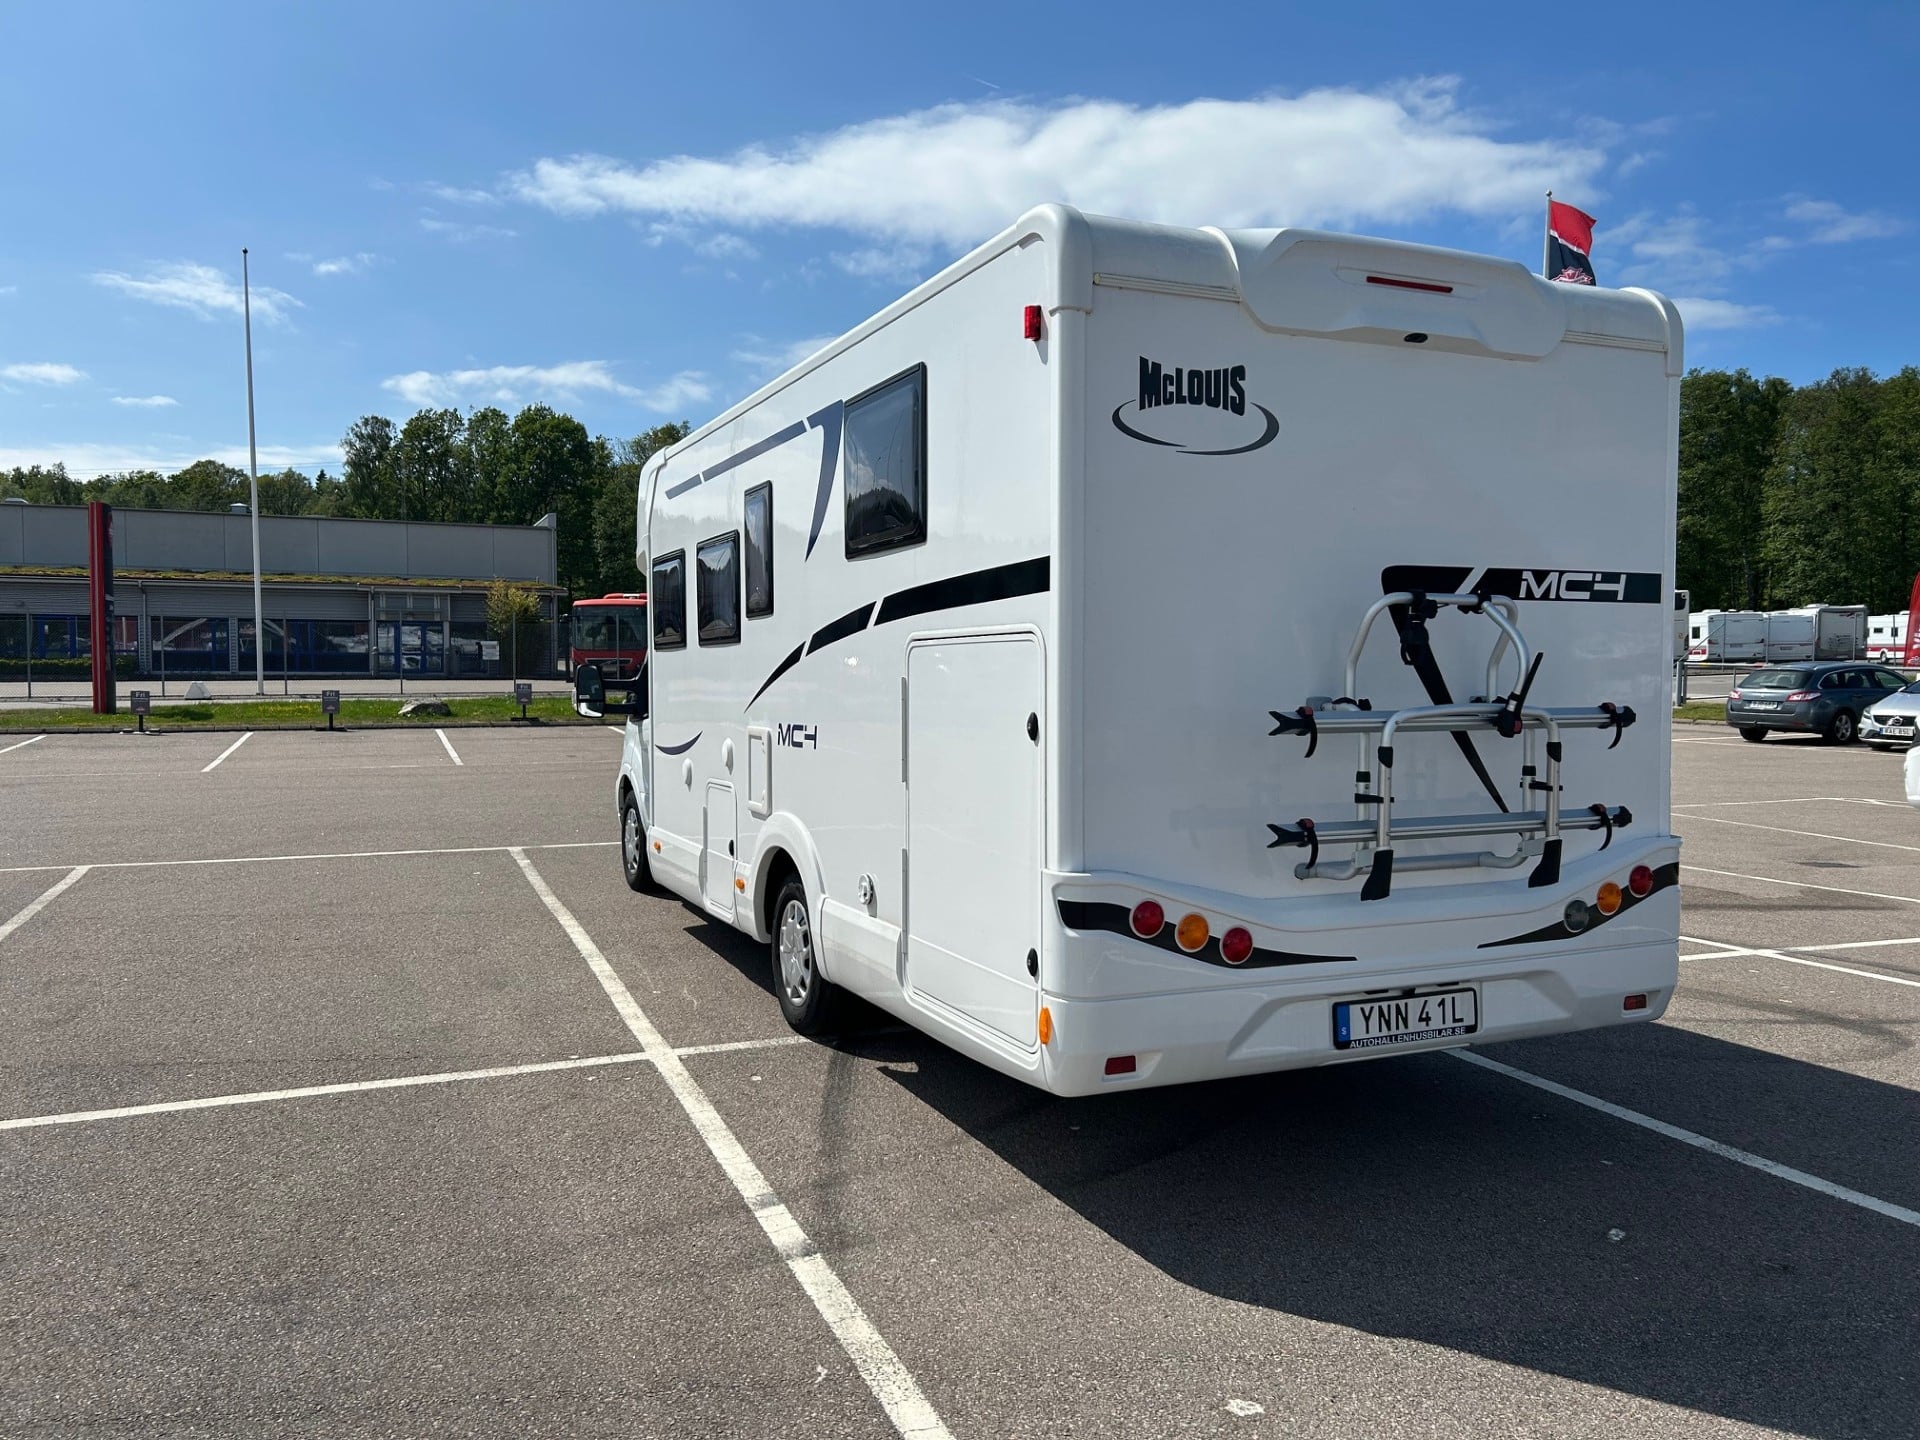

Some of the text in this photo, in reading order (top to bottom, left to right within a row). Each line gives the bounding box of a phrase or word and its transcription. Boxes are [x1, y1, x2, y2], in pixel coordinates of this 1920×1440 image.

[1519, 570, 1627, 601] MC4
[777, 722, 818, 750] MC4
[1360, 996, 1464, 1034] YNN 41L
[1350, 1026, 1466, 1049] AUTOHALLENHUSBILAR.SE
